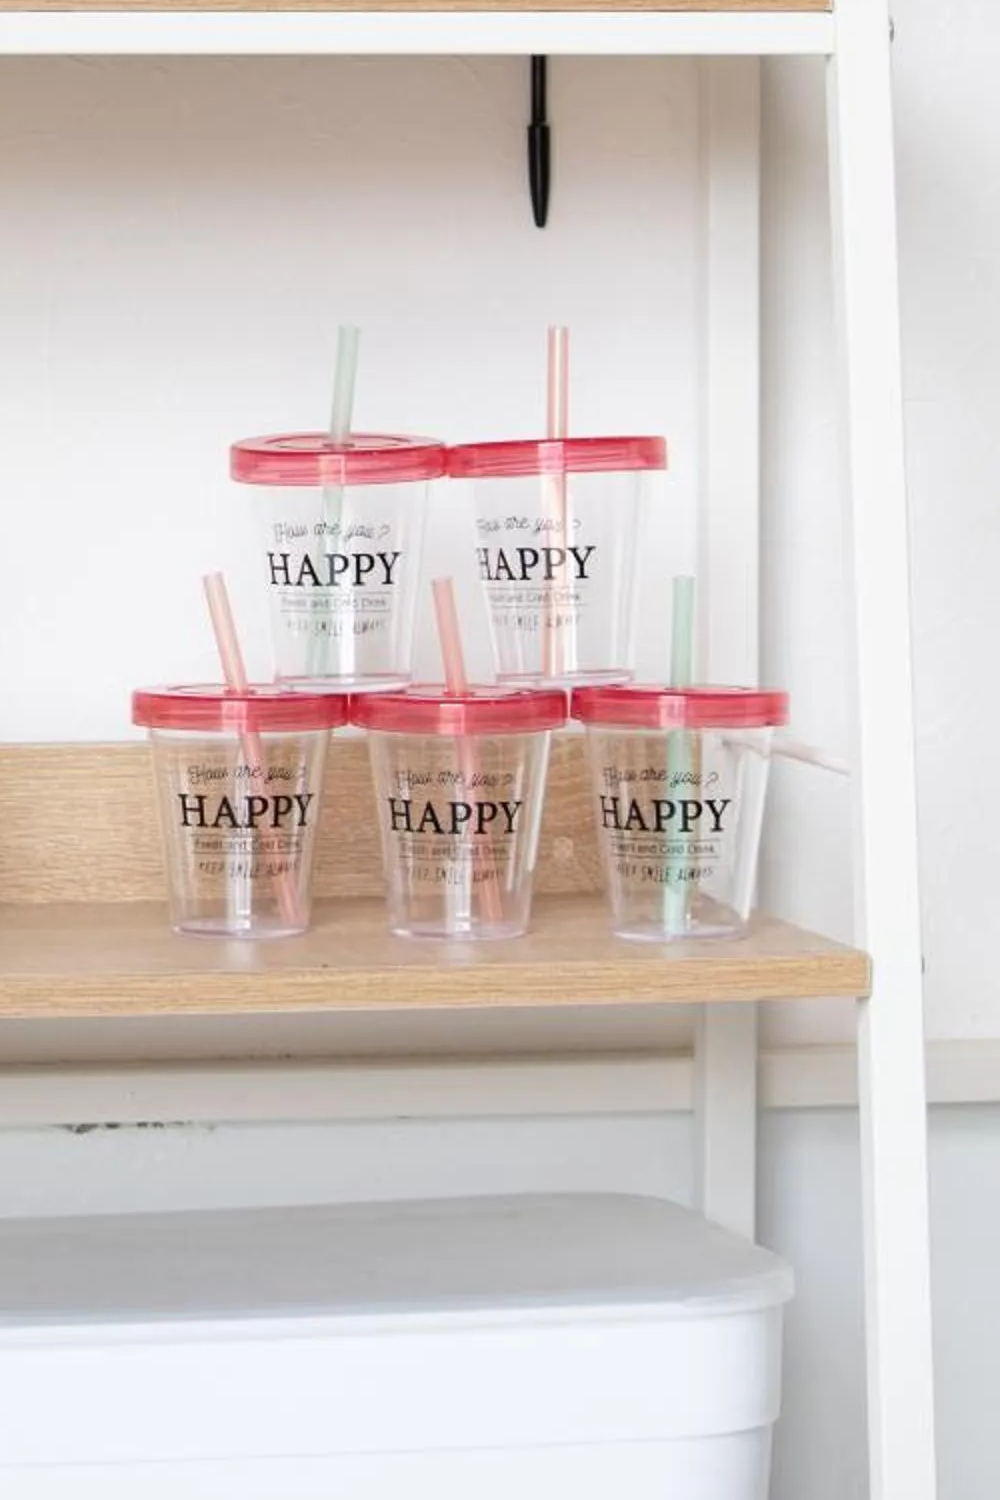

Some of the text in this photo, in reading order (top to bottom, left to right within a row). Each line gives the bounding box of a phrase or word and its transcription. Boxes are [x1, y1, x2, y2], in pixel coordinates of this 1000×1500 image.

[267, 551, 401, 587] HAPPY
[477, 546, 596, 581] HAPPY
[177, 793, 314, 828] HAPPY
[388, 797, 523, 834] HAPPY
[599, 794, 731, 833] HAPPY
